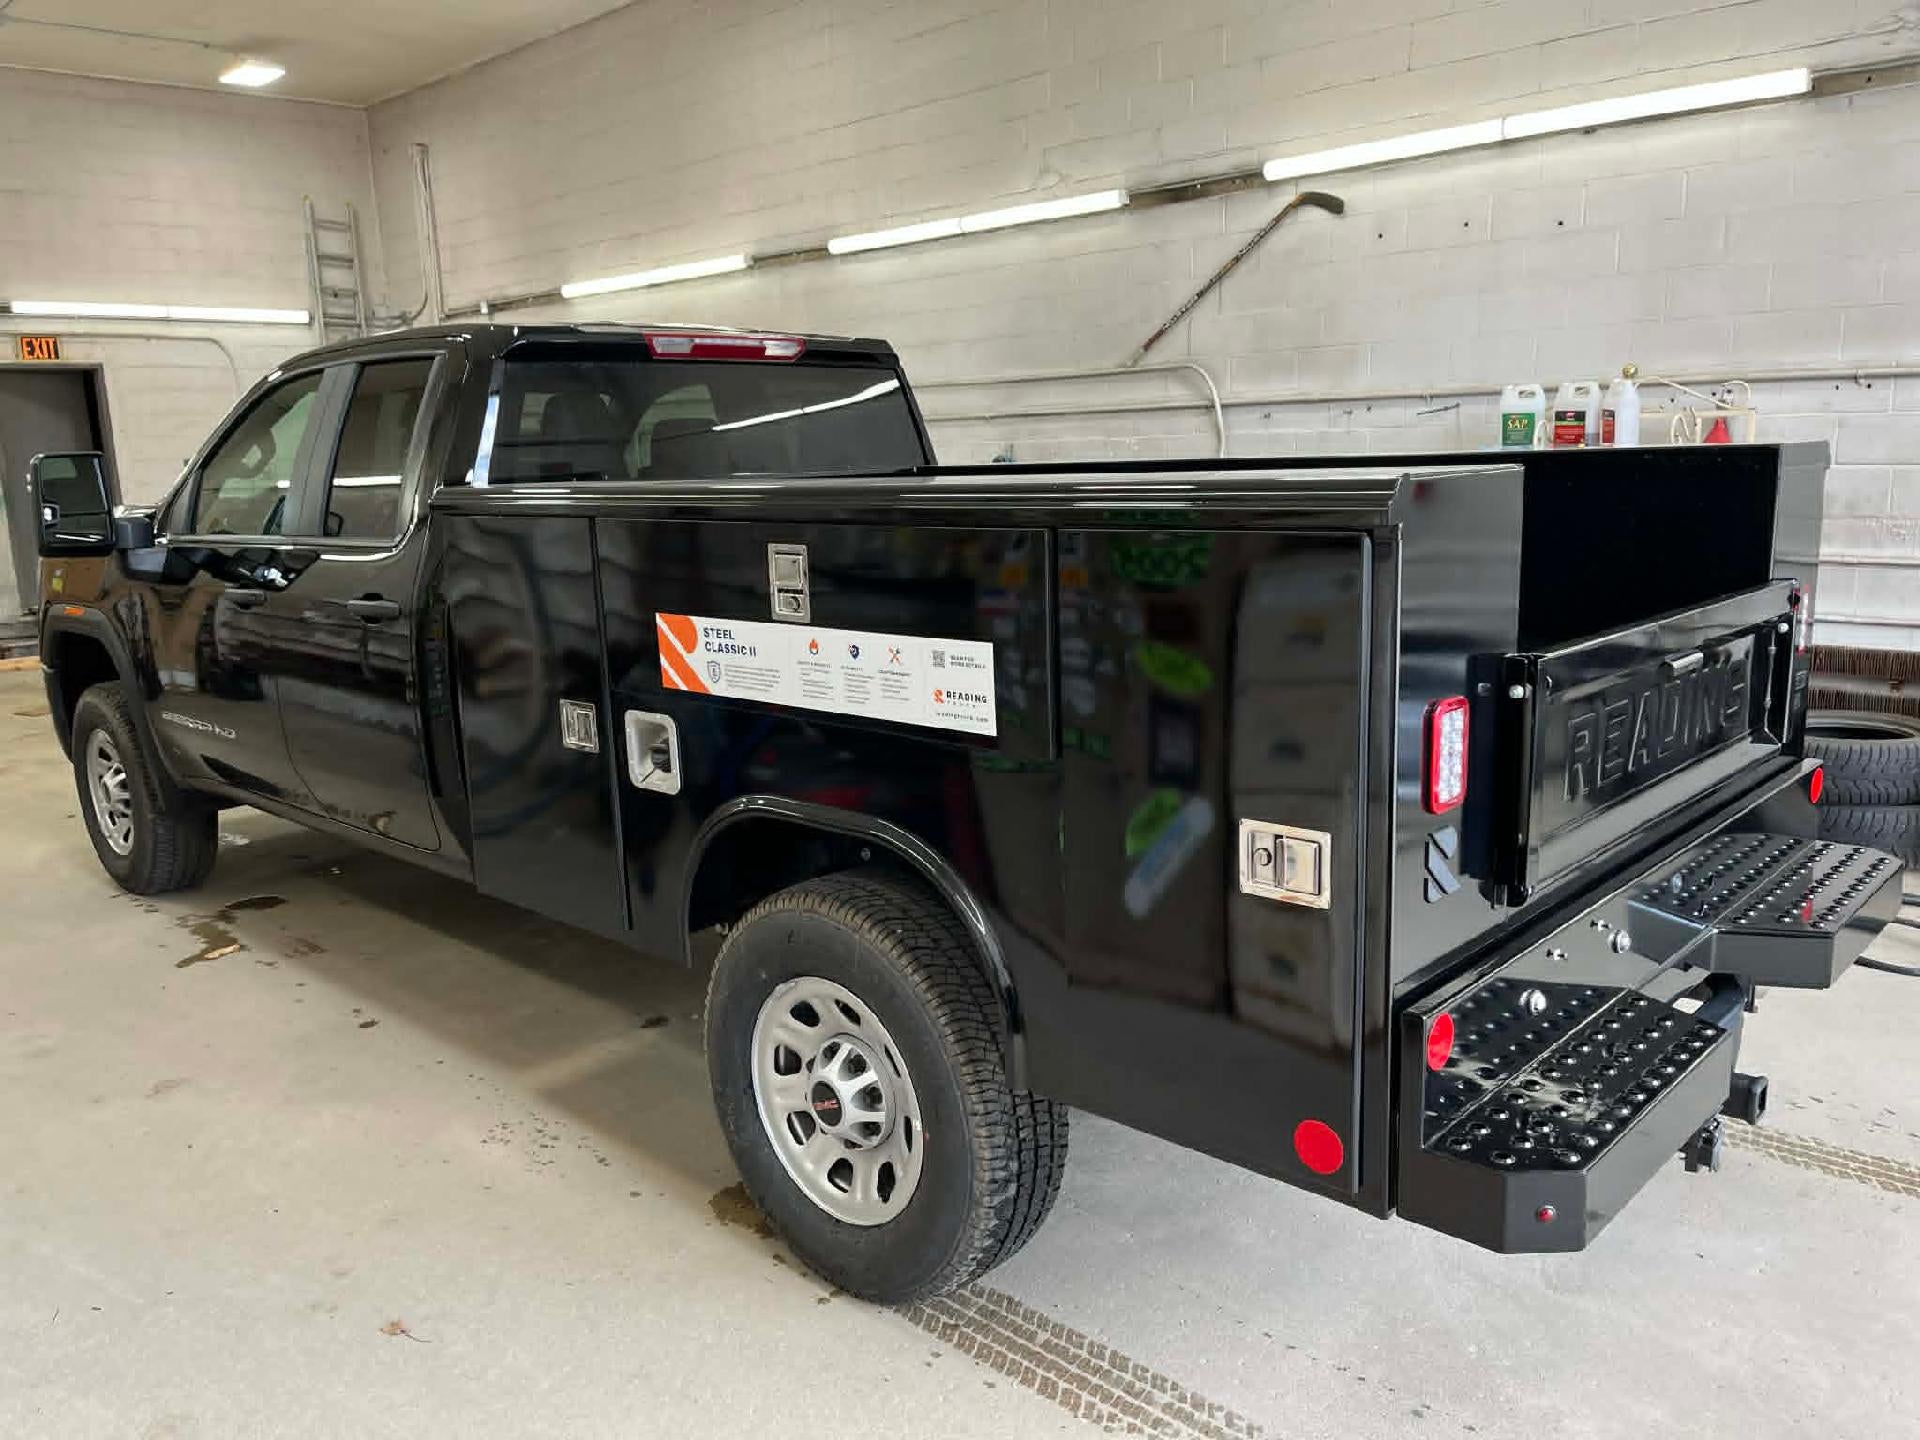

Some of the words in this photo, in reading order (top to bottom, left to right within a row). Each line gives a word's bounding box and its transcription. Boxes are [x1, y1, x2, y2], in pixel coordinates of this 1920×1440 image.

[22, 337, 56, 360] EXIT
[703, 627, 735, 640] STEEL
[704, 641, 748, 655] CLASSIC
[946, 691, 987, 703] READING
[1563, 660, 1747, 801] READING
